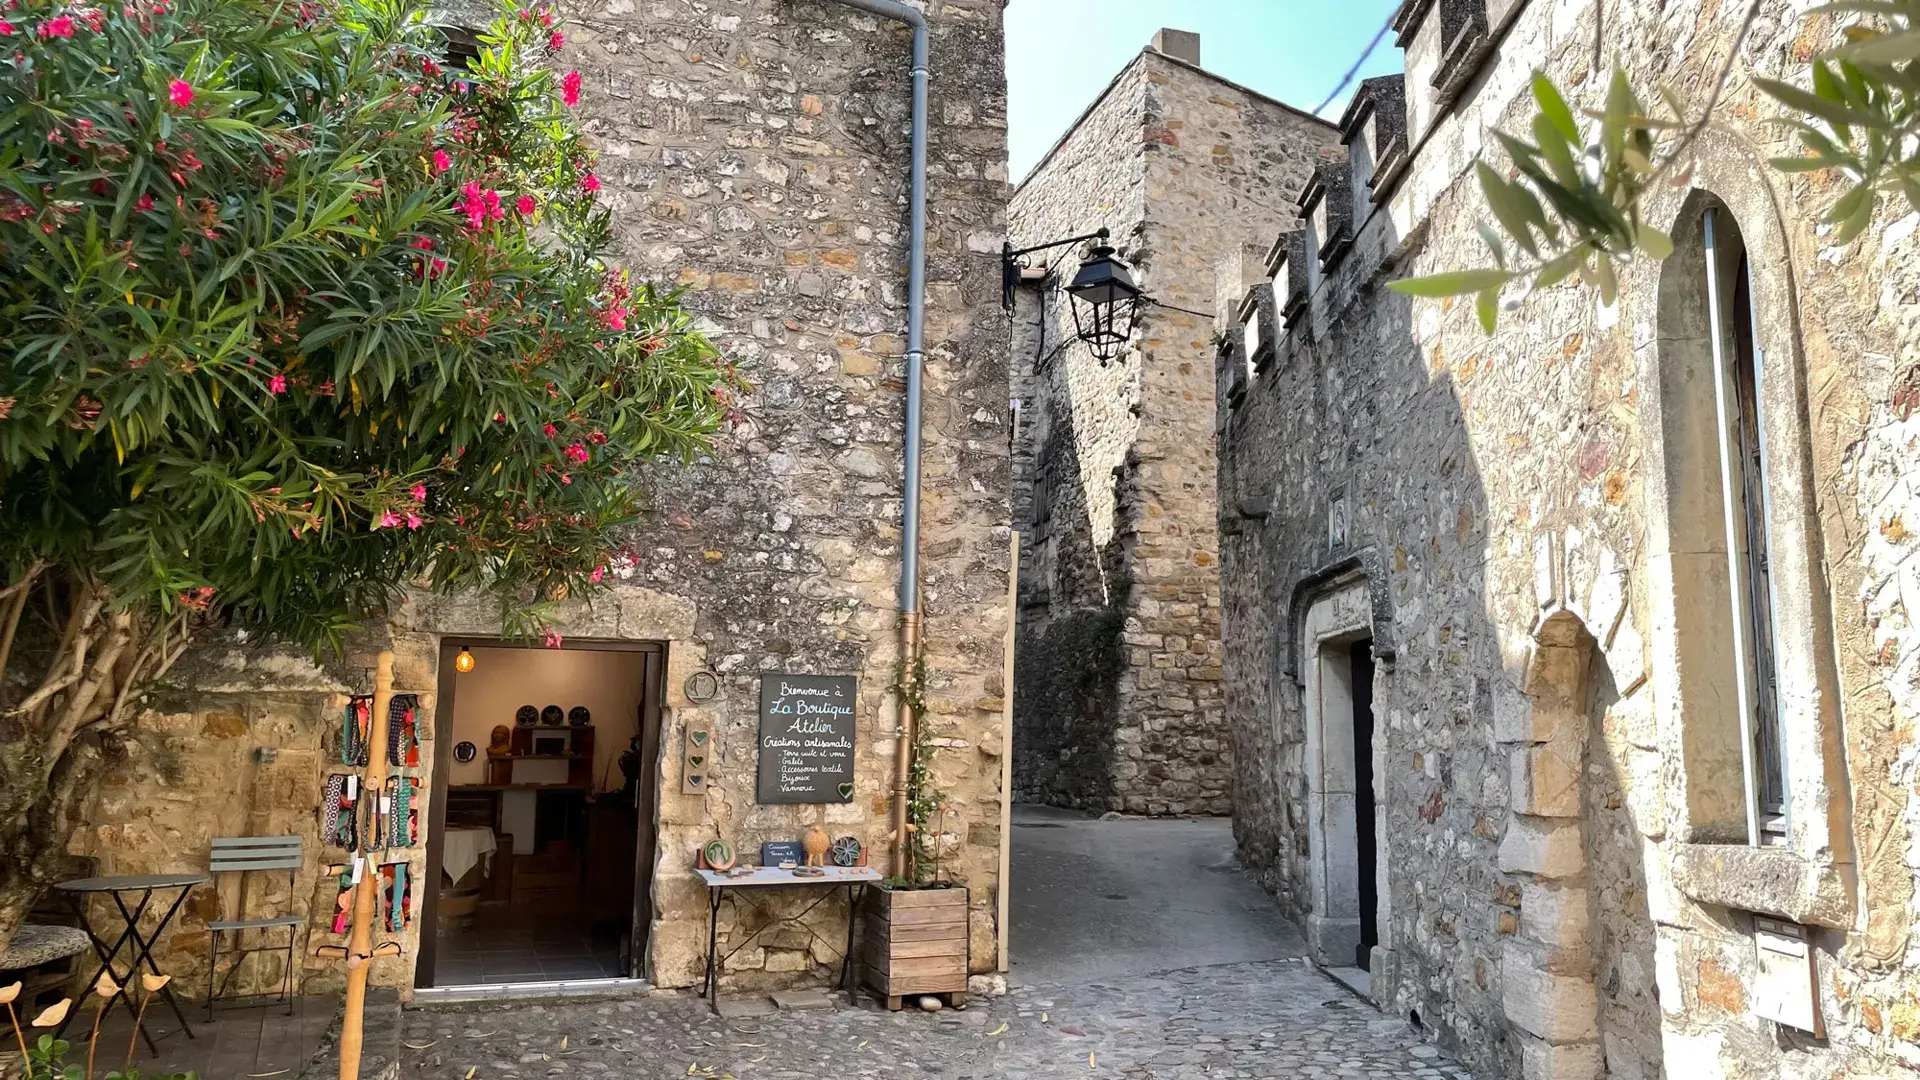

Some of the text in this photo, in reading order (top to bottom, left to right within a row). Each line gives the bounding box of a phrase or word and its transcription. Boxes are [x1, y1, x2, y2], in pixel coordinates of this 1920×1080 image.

[780, 681, 843, 697] Bienvenue à
[769, 697, 854, 720] La Boutique
[786, 717, 836, 734] Atelier
[763, 735, 852, 749] Créations artisanales
[782, 749, 799, 757] Terre
[800, 748, 817, 757] cuite
[820, 749, 827, 757] et
[781, 756, 803, 765] Galets
[781, 773, 810, 785] Bijoux
[780, 783, 815, 792] Vannerie
